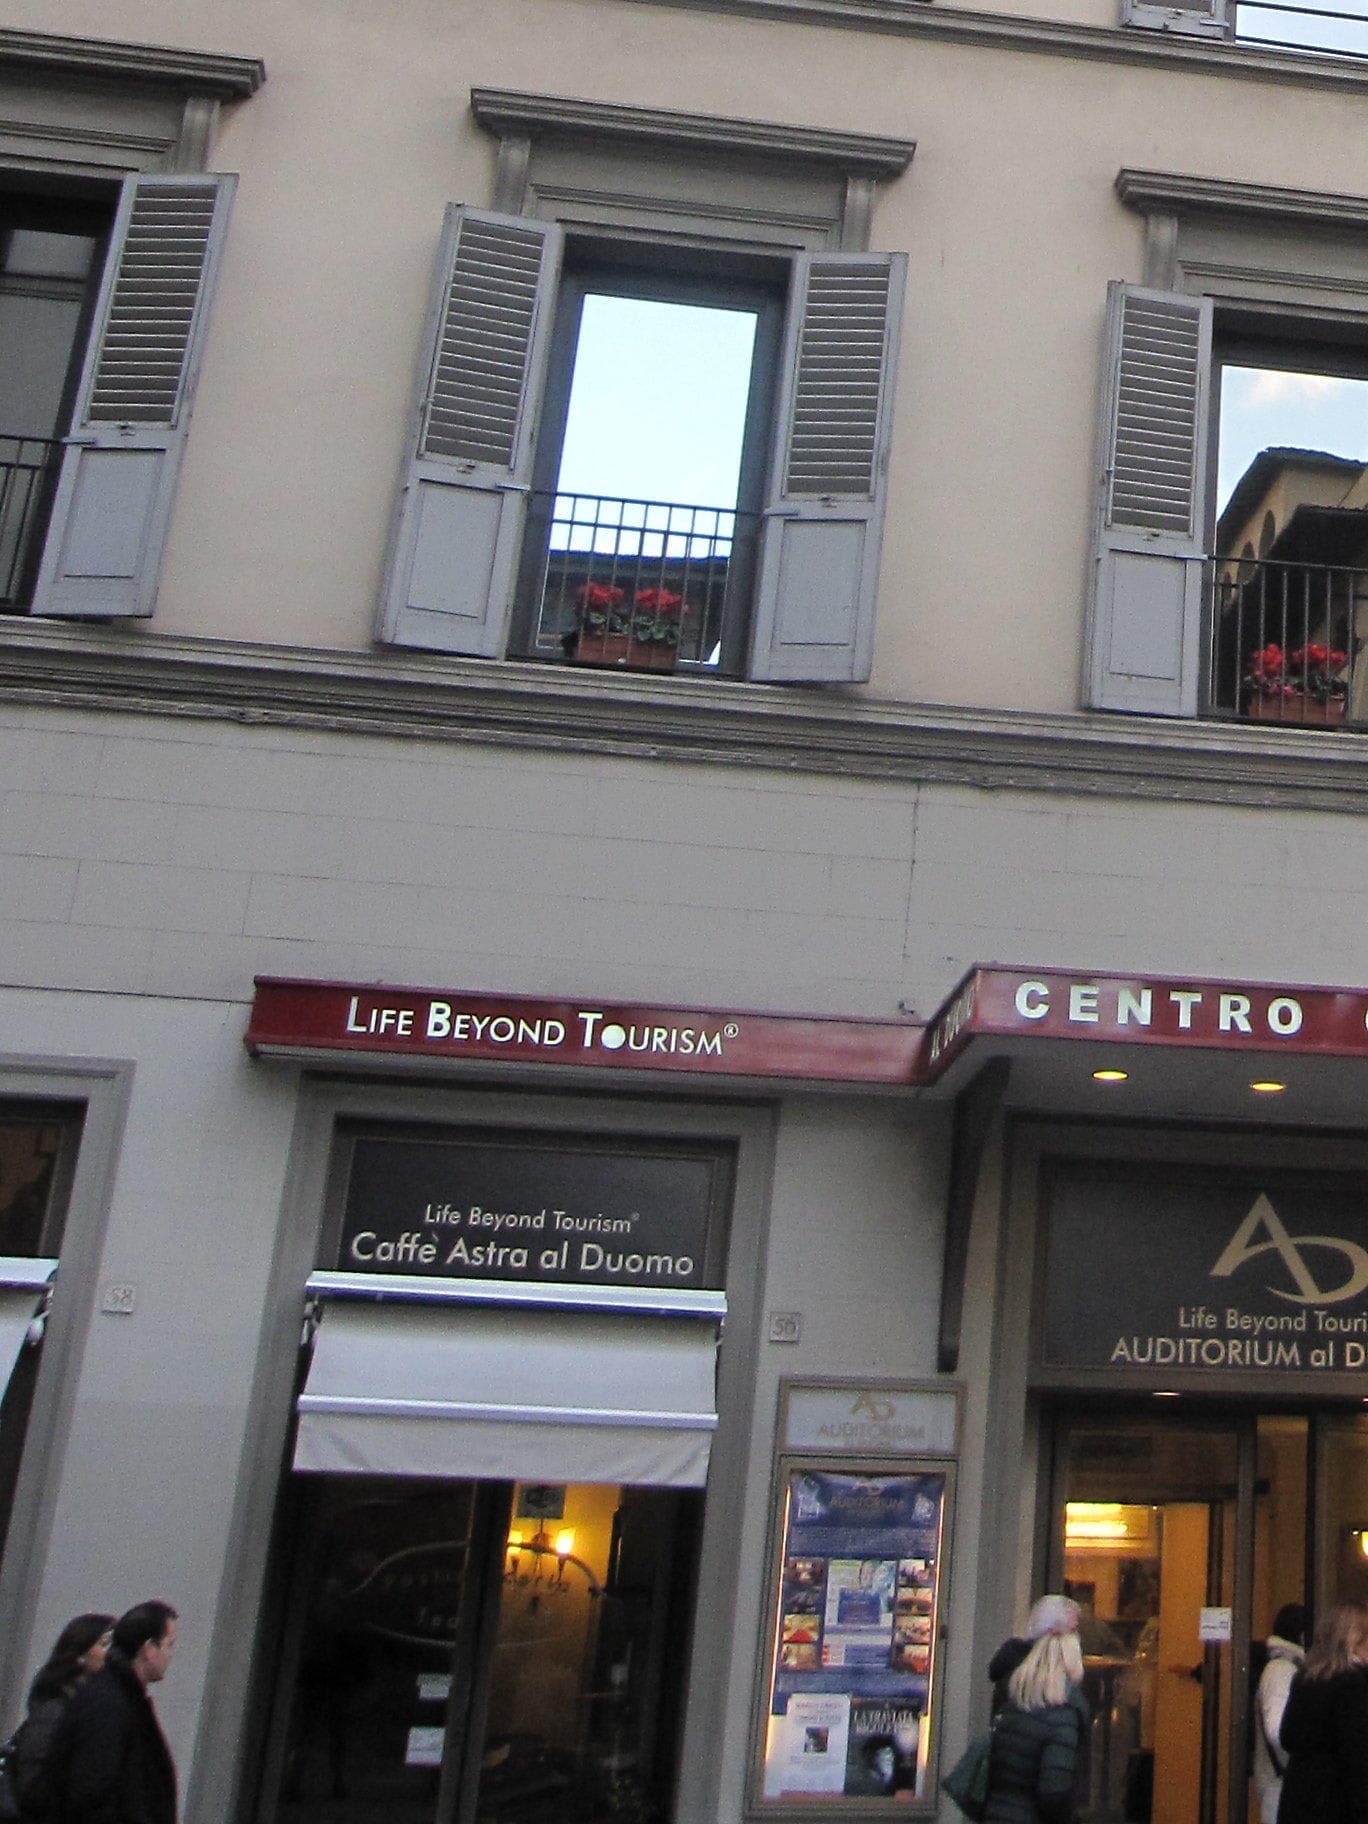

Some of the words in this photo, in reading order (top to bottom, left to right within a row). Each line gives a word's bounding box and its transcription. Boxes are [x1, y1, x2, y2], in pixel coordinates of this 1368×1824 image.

[425, 1001, 566, 1046] BEYOND
[1014, 980, 1303, 1036] CENTRO
[424, 1203, 462, 1224] Life
[467, 1206, 547, 1231] Beyond
[351, 1231, 440, 1264] Caffè
[446, 1237, 530, 1268] Astra
[539, 1240, 570, 1270] al
[579, 1243, 695, 1276] Duomo
[1178, 1306, 1217, 1329] Life
[1226, 1307, 1306, 1336] Beyond
[1110, 1337, 1301, 1367] AUDITORIUM
[1310, 1341, 1334, 1367] al
